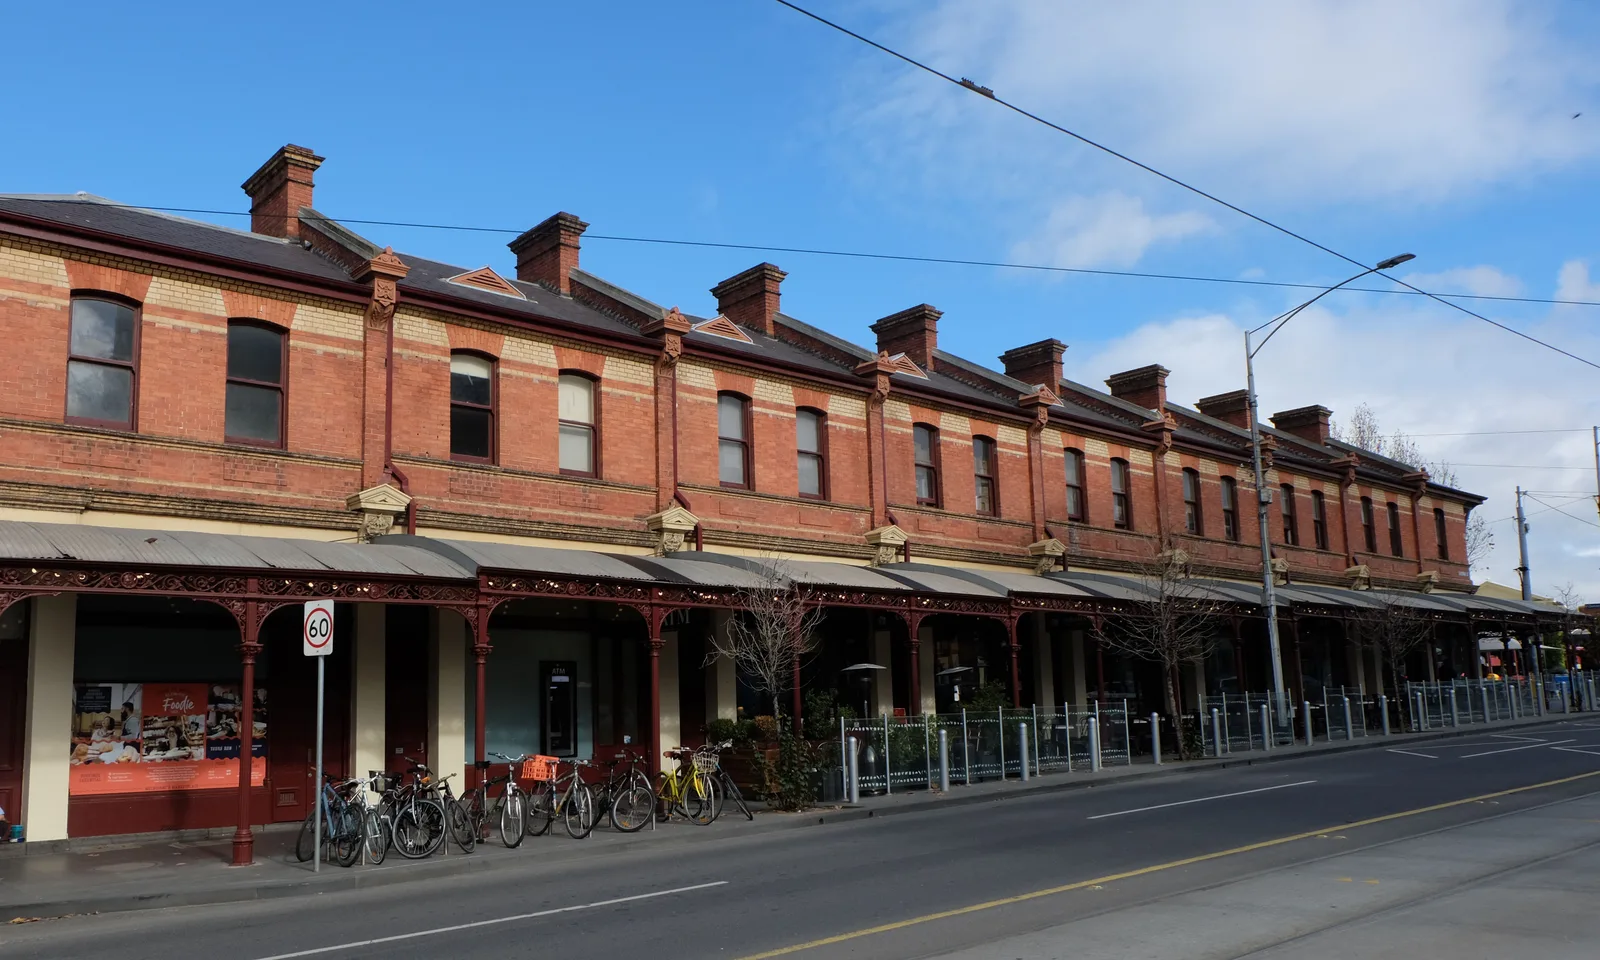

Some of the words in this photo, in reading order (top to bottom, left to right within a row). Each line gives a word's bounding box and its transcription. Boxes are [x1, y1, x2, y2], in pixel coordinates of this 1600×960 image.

[309, 618, 329, 638] 60
[551, 667, 566, 675] ATM
[162, 695, 195, 714] Foodie
